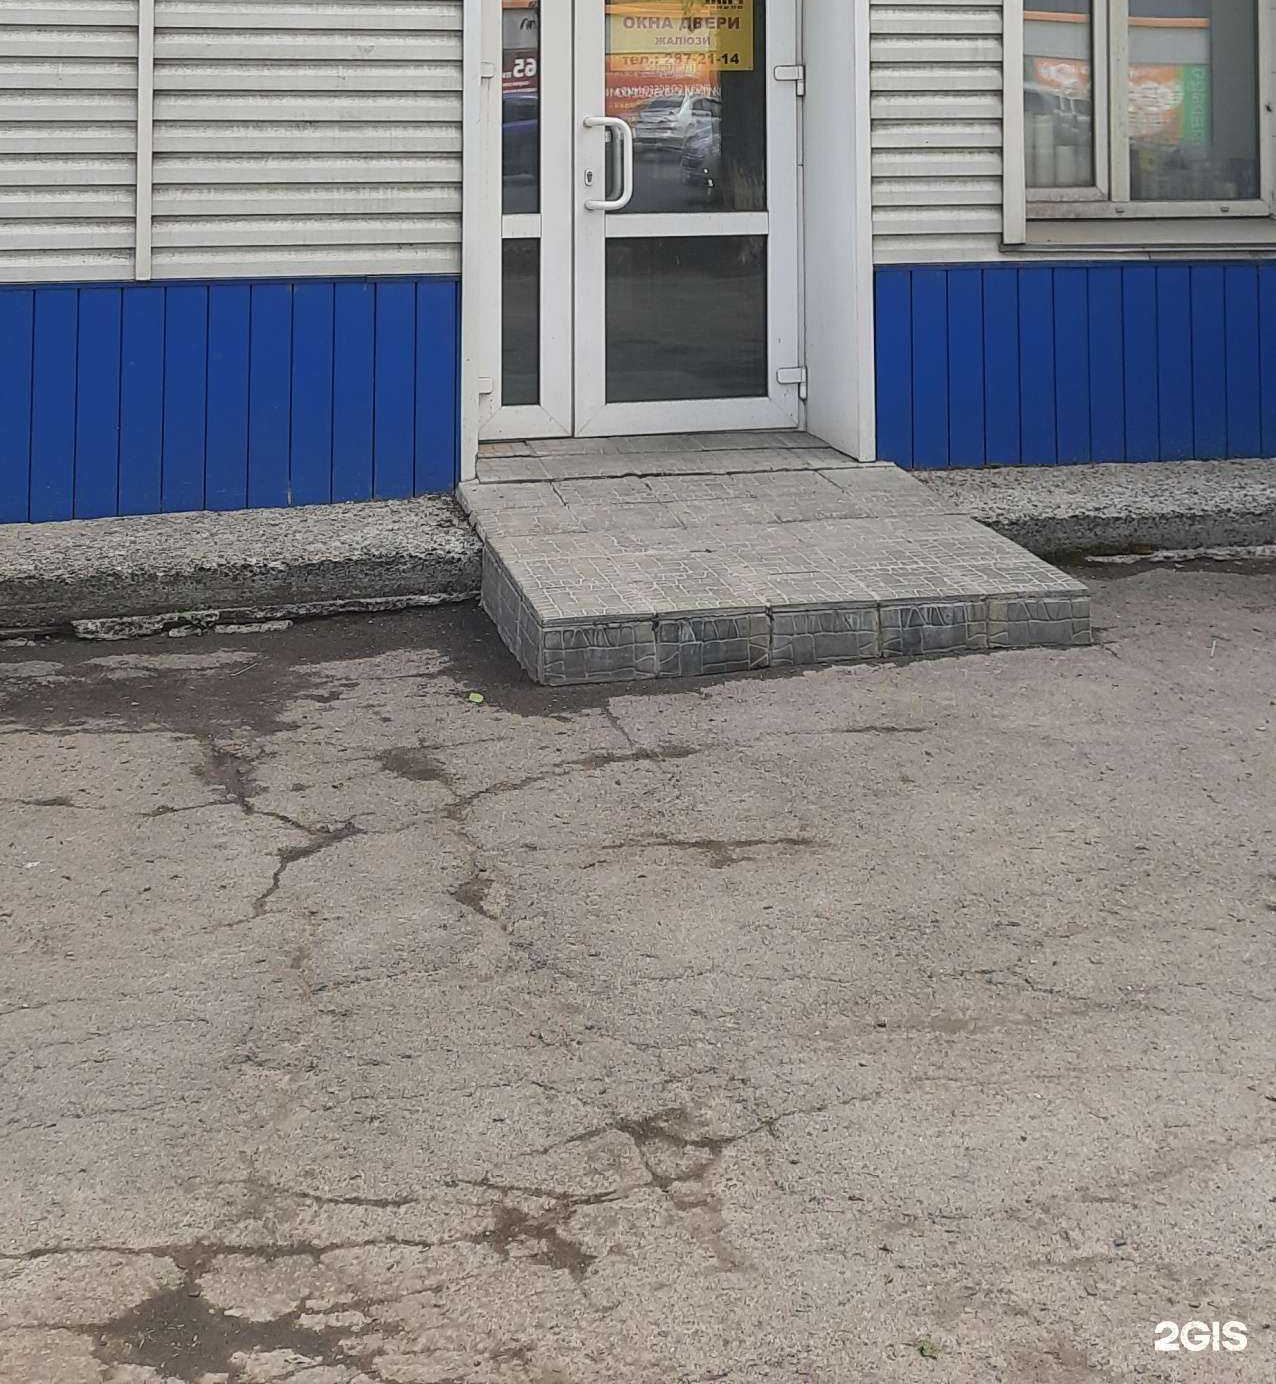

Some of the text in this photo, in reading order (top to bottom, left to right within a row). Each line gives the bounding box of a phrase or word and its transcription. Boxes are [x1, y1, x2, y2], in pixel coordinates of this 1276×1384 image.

[622, 16, 740, 31] ОКНА ДВЕРИ
[655, 36, 711, 47] ЖАЛЮЗИ
